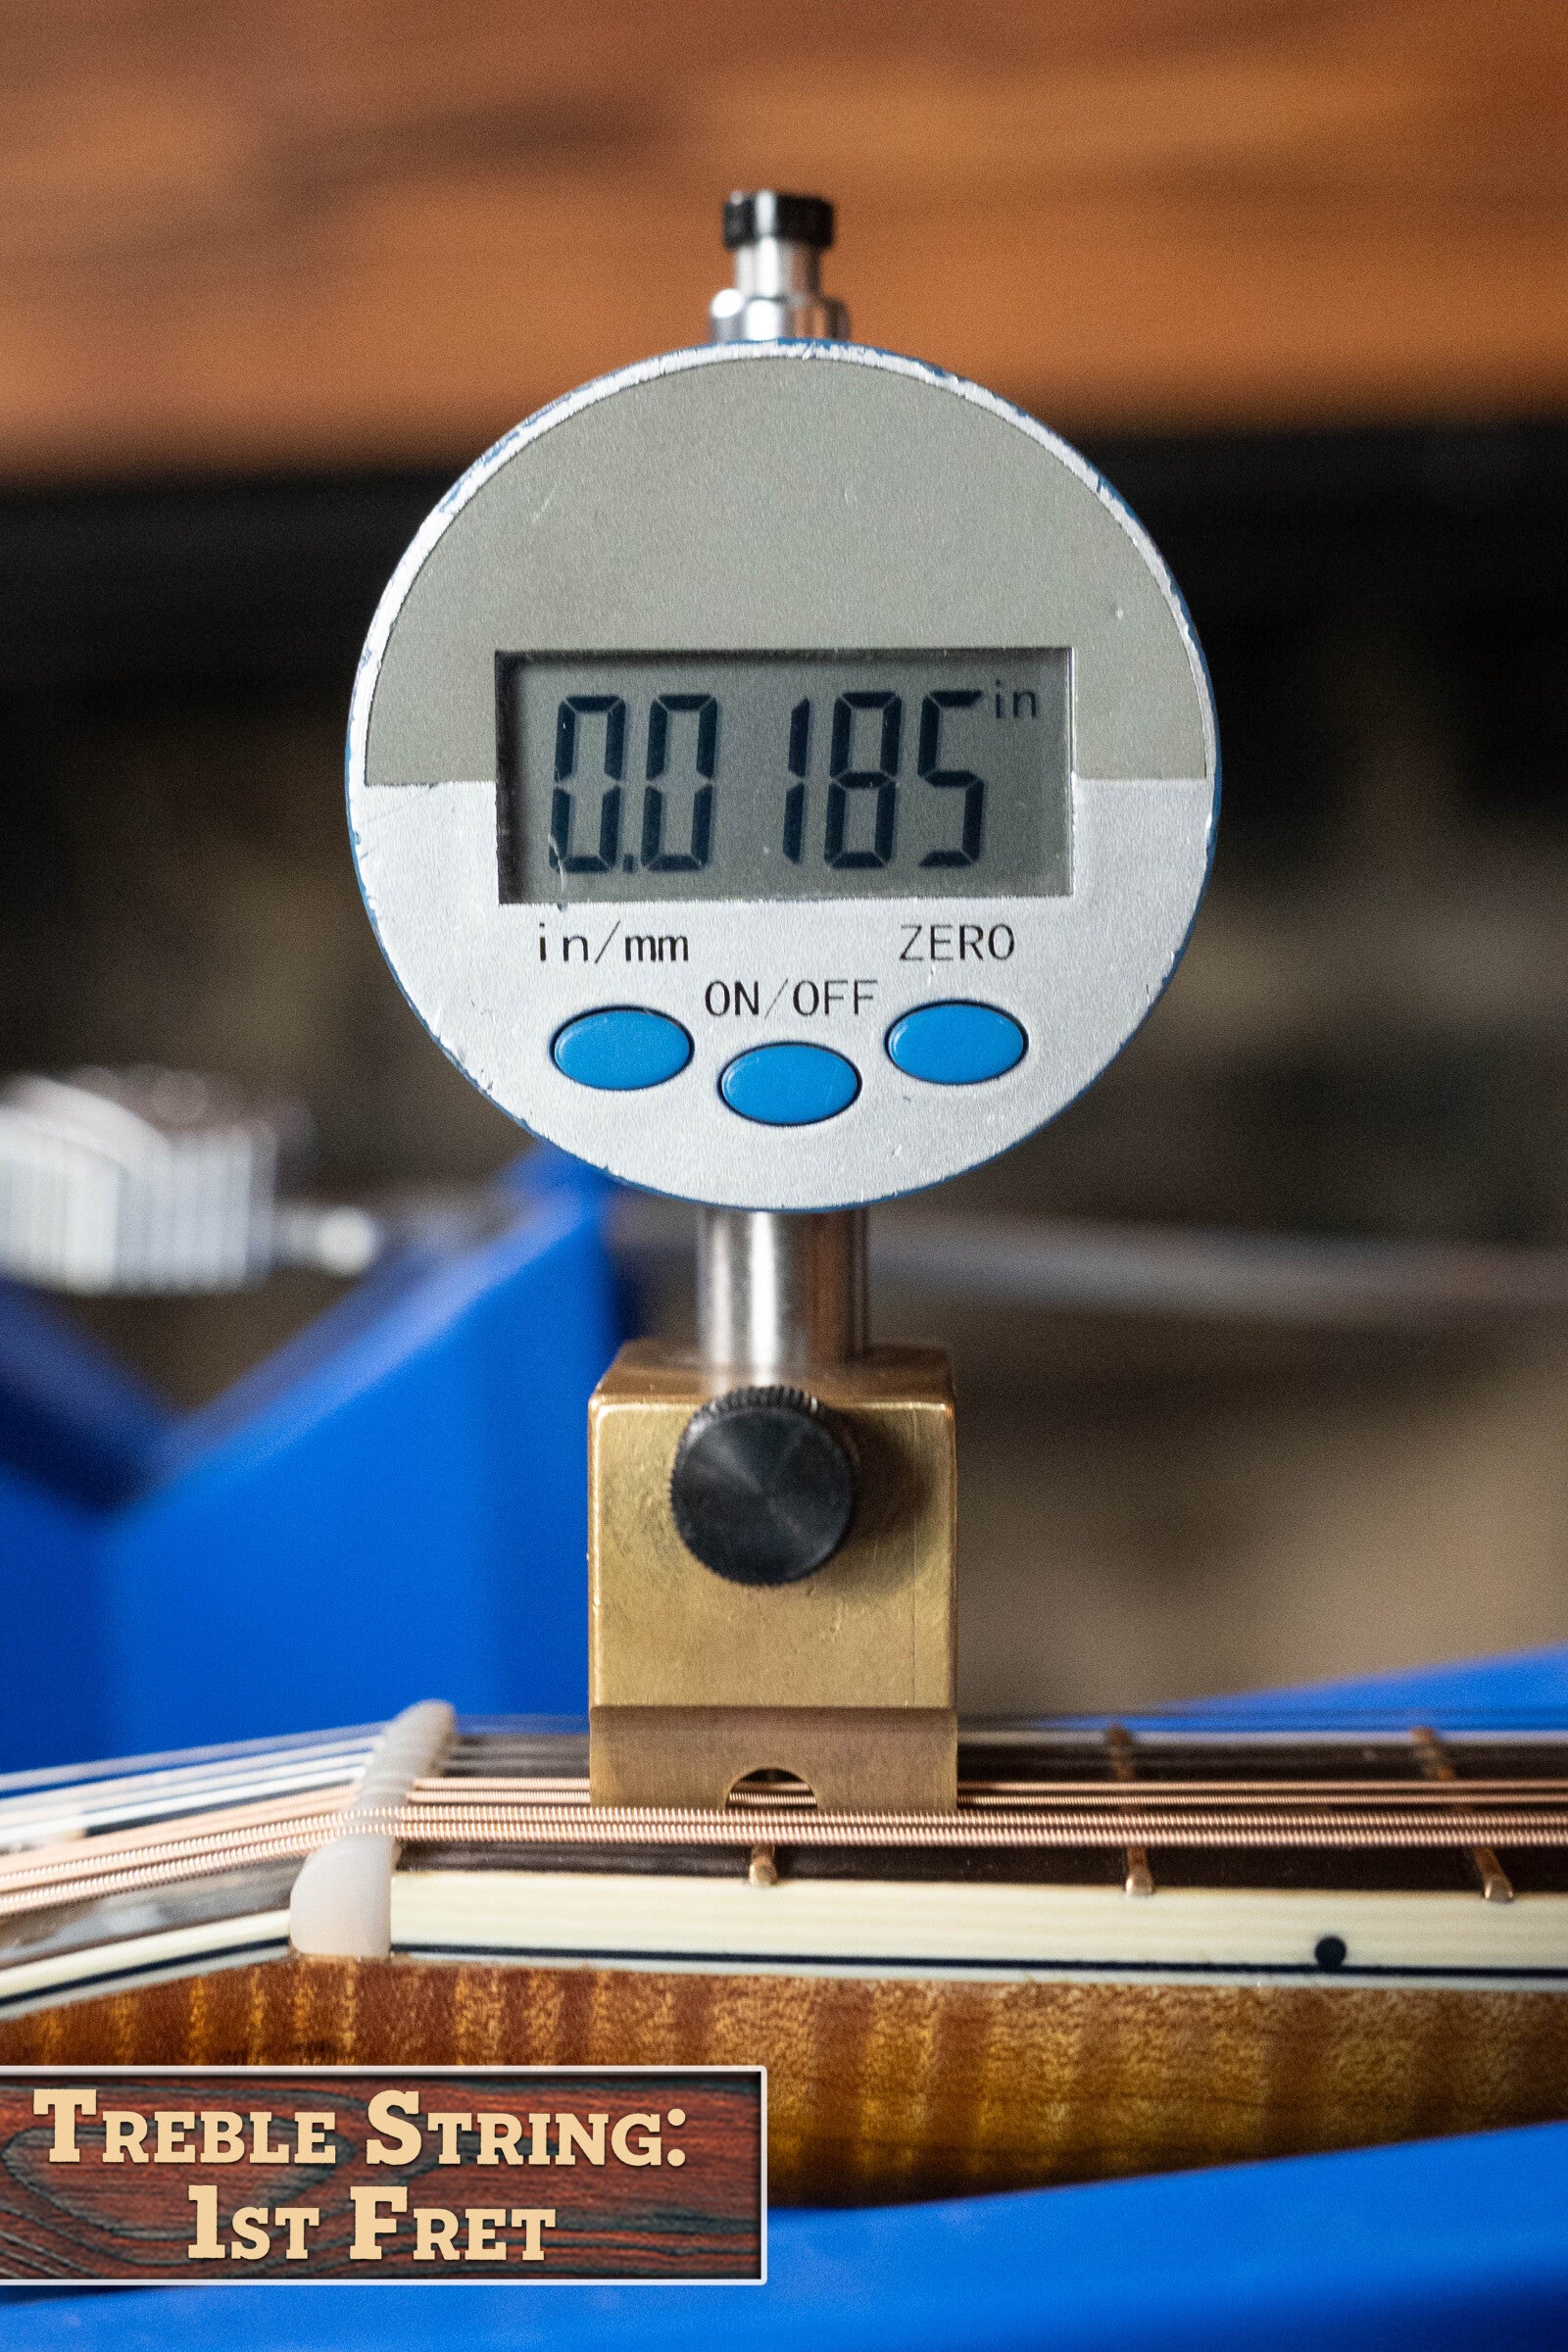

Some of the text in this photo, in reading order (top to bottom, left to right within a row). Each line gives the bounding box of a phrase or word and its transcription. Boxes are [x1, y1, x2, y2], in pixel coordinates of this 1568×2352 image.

[549, 679, 1038, 873] 0.0185 in
[538, 920, 689, 965] in/mm
[899, 923, 1015, 961] ZERO
[704, 978, 878, 1020] ON/OFF
